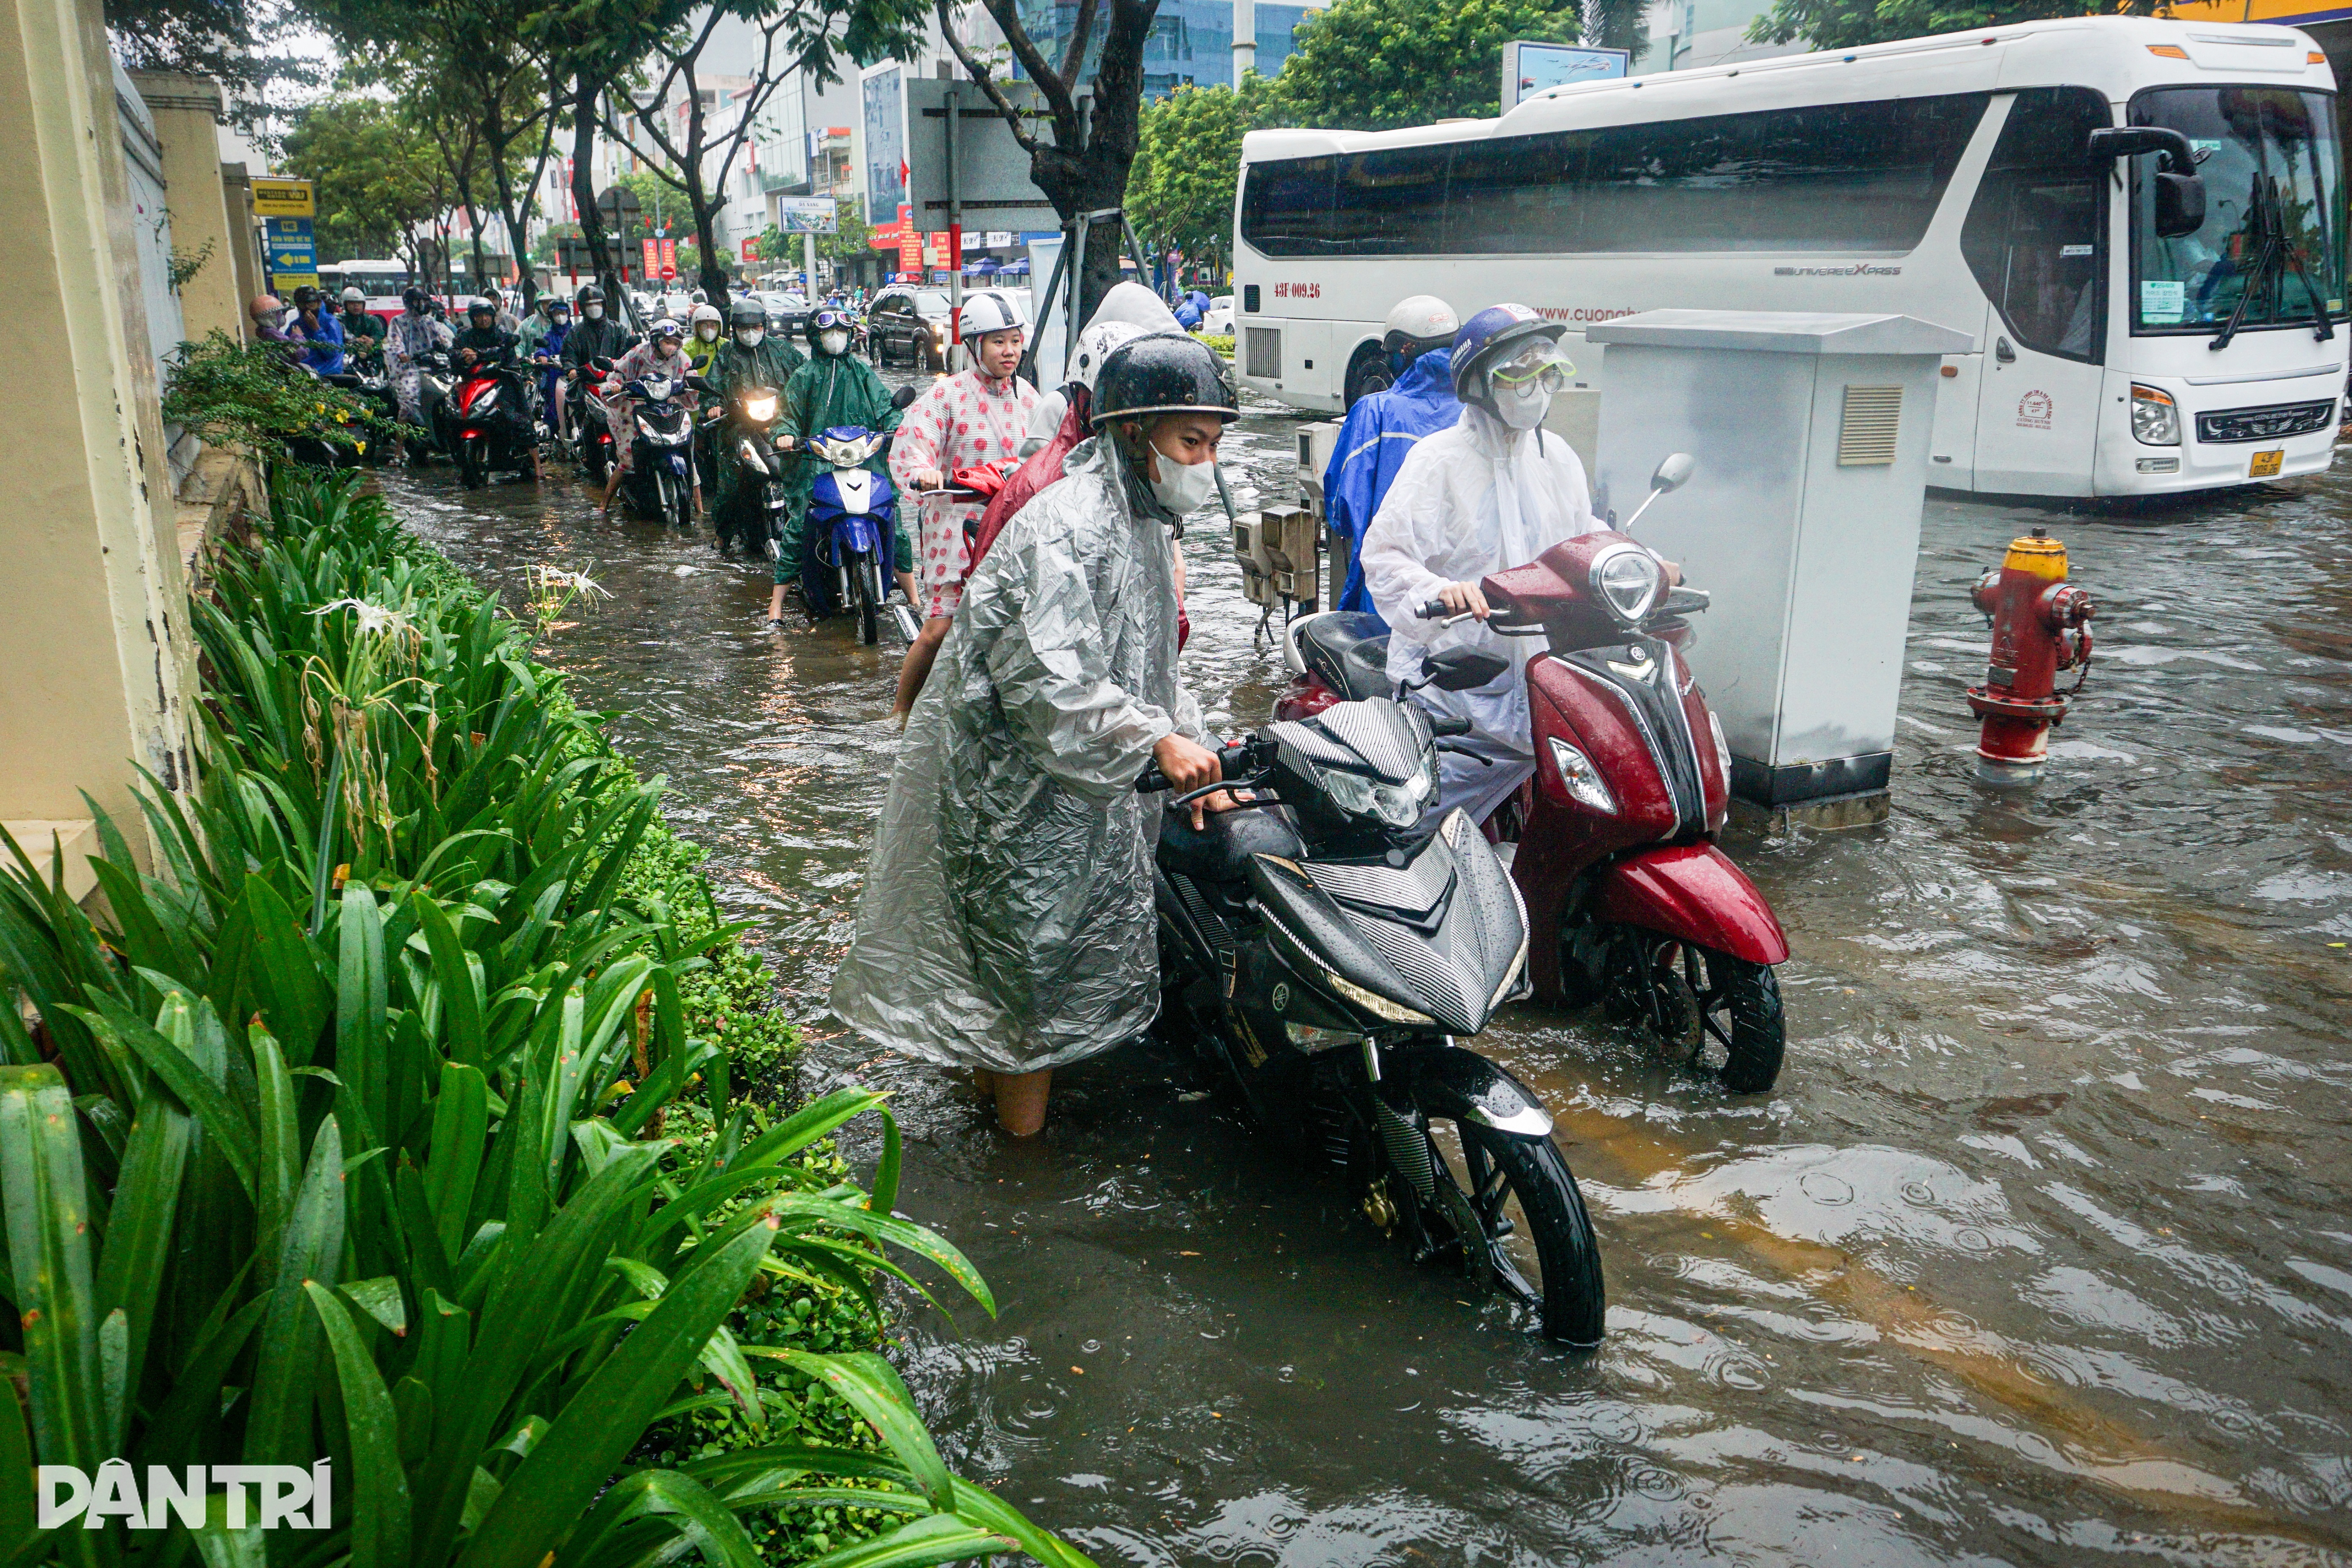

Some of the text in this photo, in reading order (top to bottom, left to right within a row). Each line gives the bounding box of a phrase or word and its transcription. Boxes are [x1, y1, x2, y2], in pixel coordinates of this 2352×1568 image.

[1274, 282, 1320, 298] 43F 009.26
[1452, 338, 1472, 363] YAMAHA
[2261, 452, 2276, 463] 43F
[1321, 661, 1343, 691] Grande
